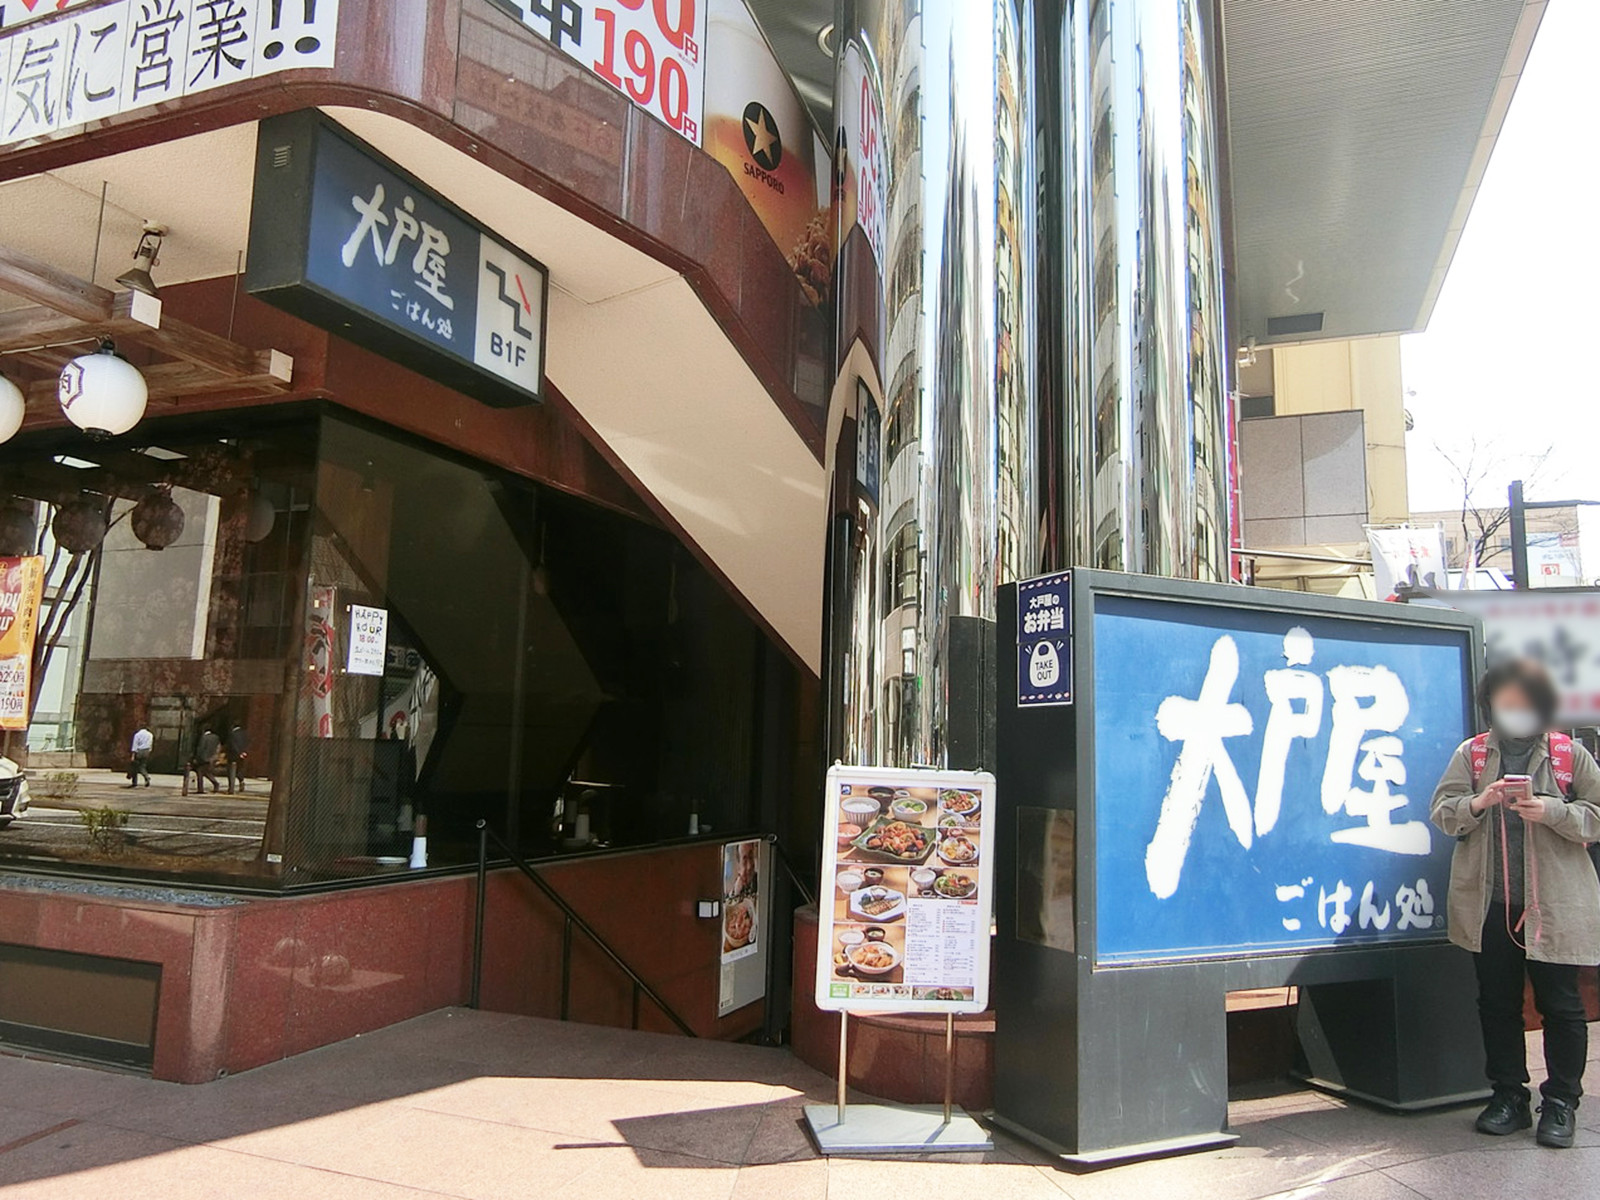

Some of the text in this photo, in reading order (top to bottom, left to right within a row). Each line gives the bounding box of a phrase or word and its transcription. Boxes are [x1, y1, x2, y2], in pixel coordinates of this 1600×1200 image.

[0, 0, 321, 136] 気に営業!!
[593, 7, 697, 142] 190円
[744, 162, 785, 195] SAPPORO
[341, 183, 454, 310] 大戸屋
[390, 288, 455, 341] ごはん処
[490, 331, 526, 367] B1F
[1024, 606, 1064, 634] お弁当
[1035, 659, 1054, 669] TAKE
[1037, 670, 1052, 681] OUT
[1145, 626, 1431, 899] 大戸屋
[1275, 877, 1434, 934] ごはん処
